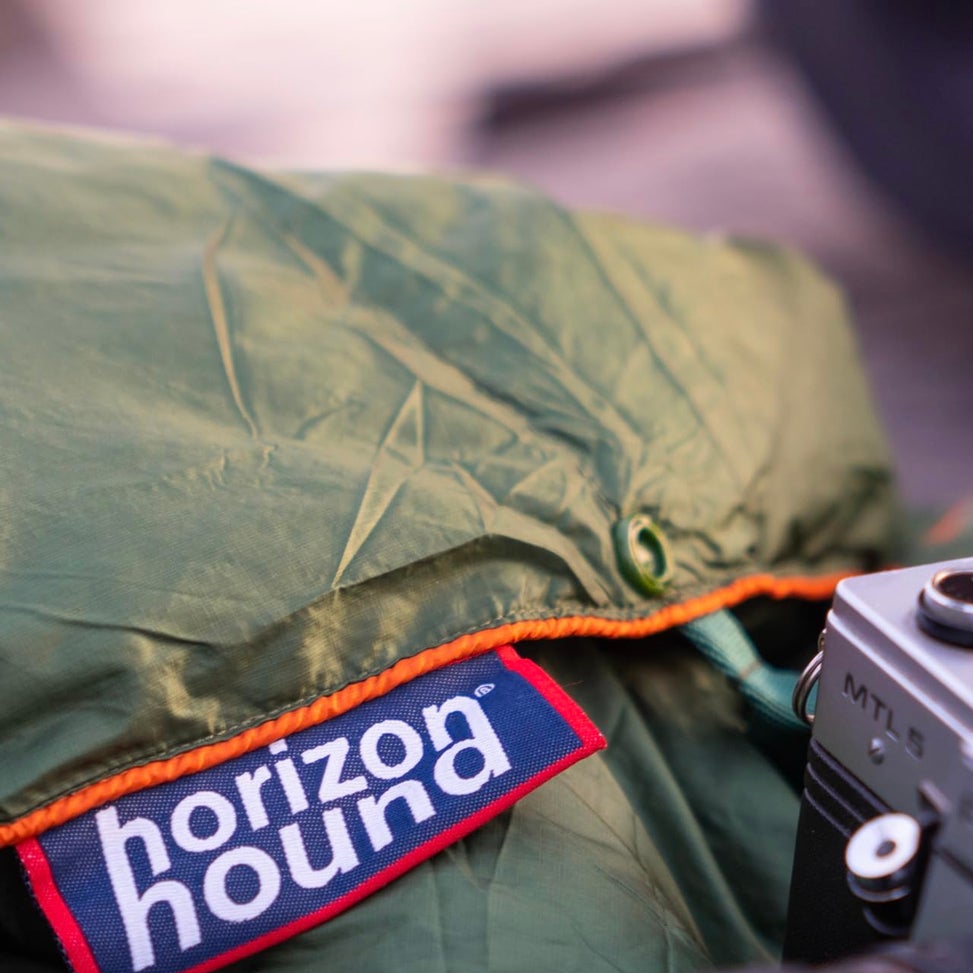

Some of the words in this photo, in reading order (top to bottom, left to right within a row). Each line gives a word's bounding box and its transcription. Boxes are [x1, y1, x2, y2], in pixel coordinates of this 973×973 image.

[95, 695, 502, 876] horizon
[842, 671, 900, 741] MTL
[112, 732, 512, 973] hound
